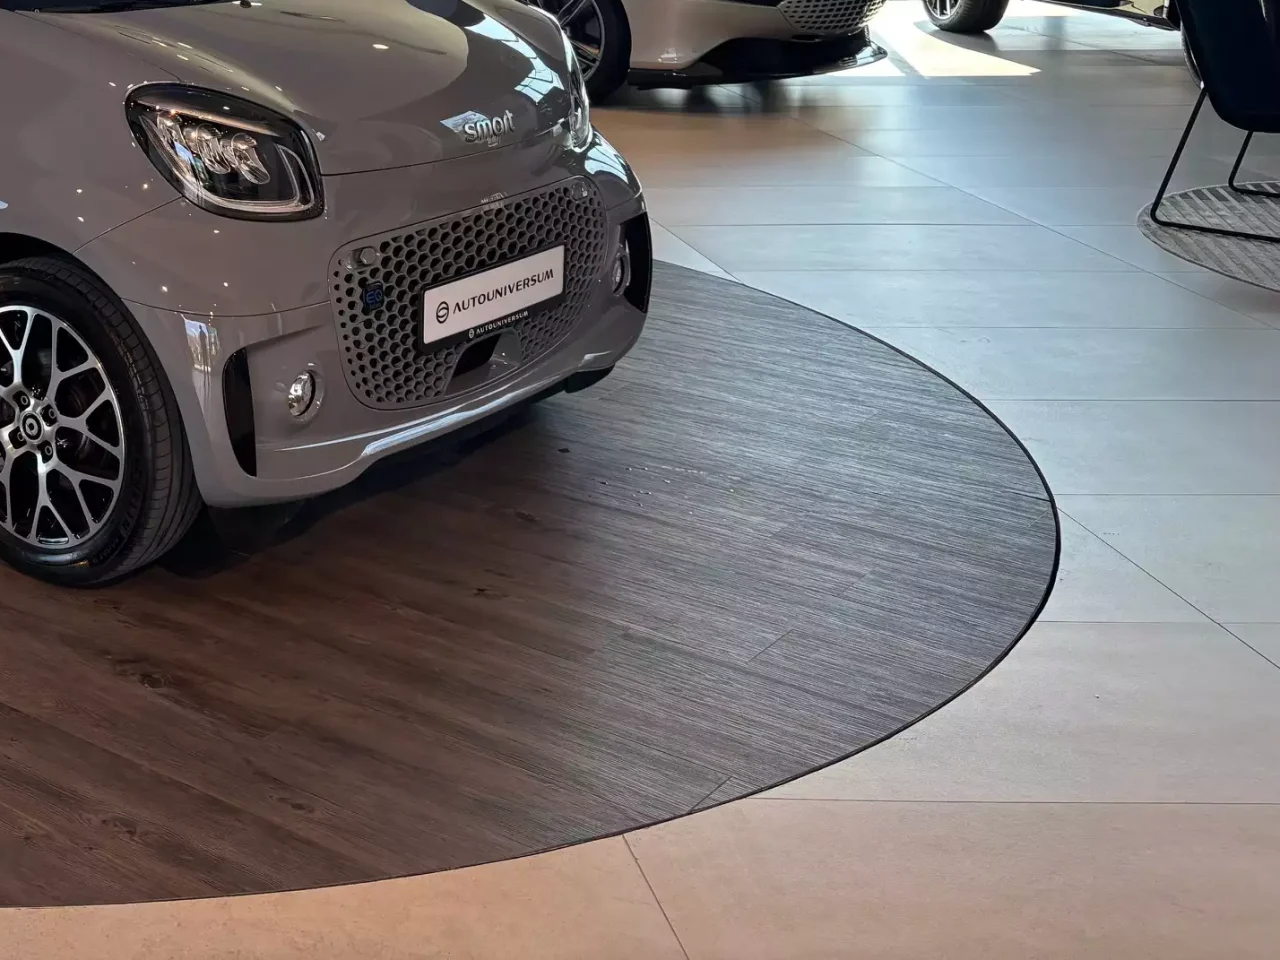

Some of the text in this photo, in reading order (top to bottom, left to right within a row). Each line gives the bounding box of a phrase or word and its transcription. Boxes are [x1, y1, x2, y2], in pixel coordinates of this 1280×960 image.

[463, 109, 516, 141] smart
[452, 268, 554, 315] AUTOUNIVERSUM
[475, 310, 529, 335] AUTOUNIVERSUM
